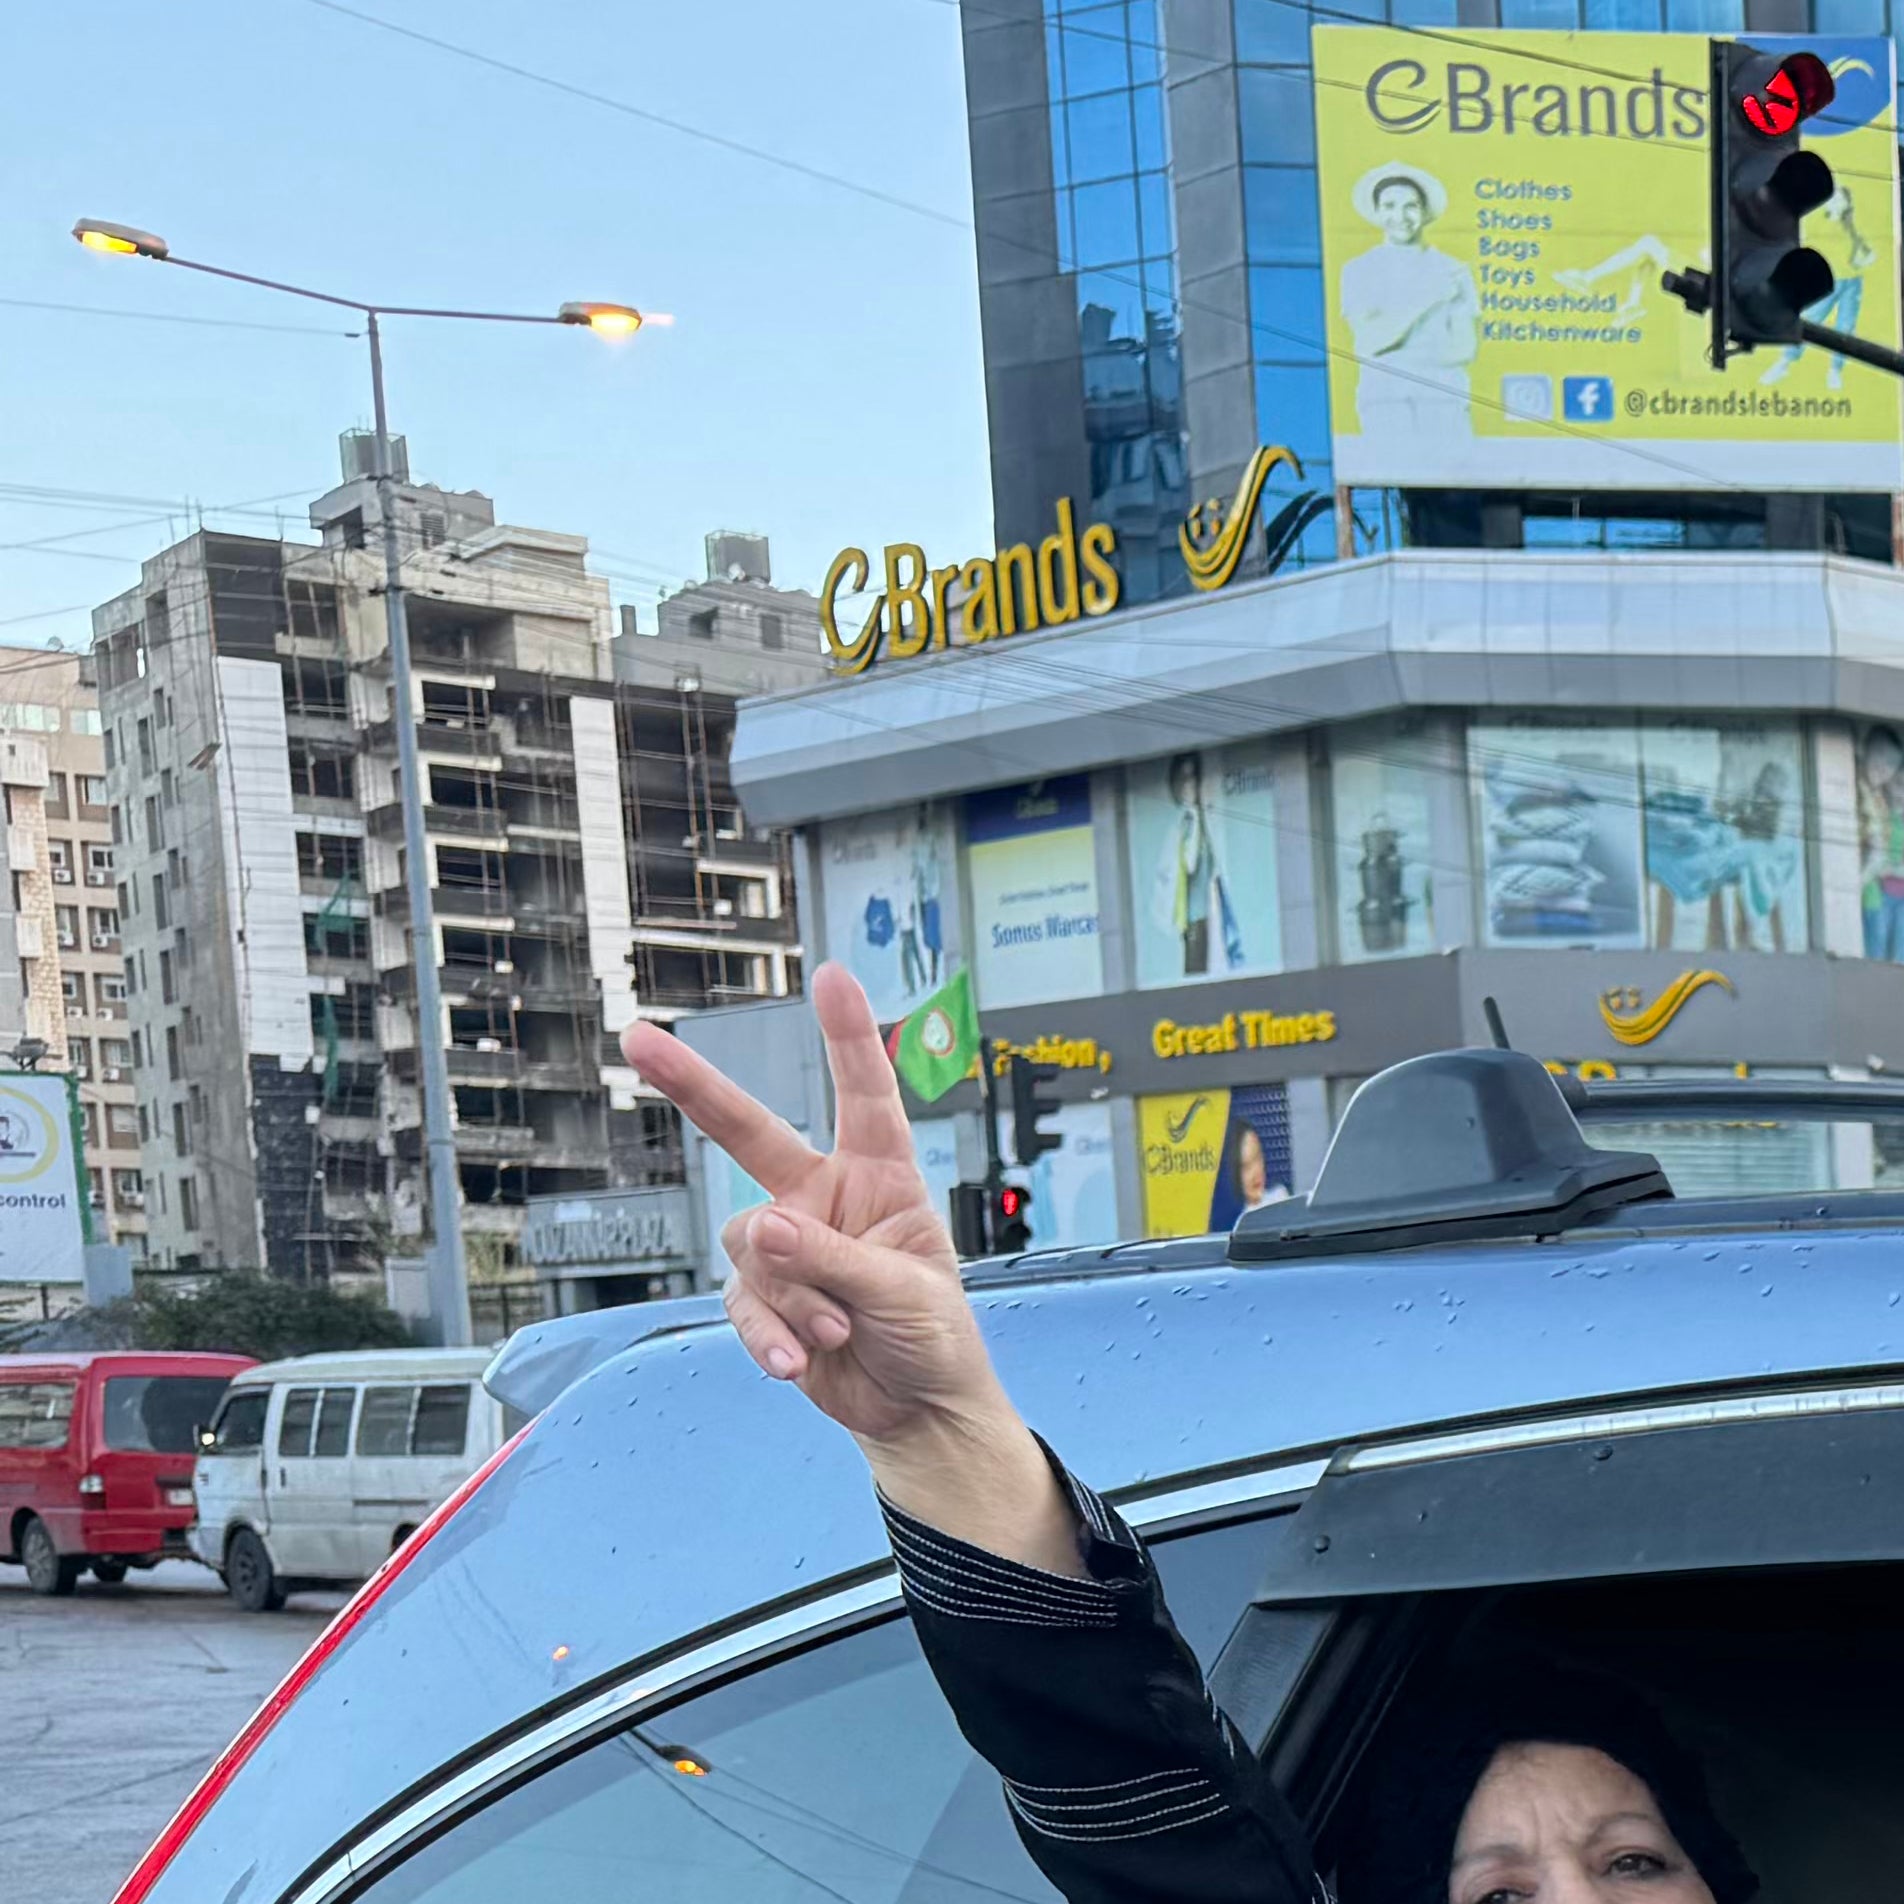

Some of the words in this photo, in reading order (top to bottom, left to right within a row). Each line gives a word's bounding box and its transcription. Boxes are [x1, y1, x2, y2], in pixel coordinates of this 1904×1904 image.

[1475, 178, 1573, 201] Clothes
[1477, 209, 1553, 231] Shoes
[1479, 236, 1541, 261] Bags
[1480, 264, 1536, 288] Toys
[1482, 291, 1617, 313] Household
[1483, 320, 1642, 343] Kitchenware
[1624, 388, 1852, 419] @cbrandslebanon
[1152, 1014, 1238, 1059] Great
[1242, 1010, 1336, 1049] Times
